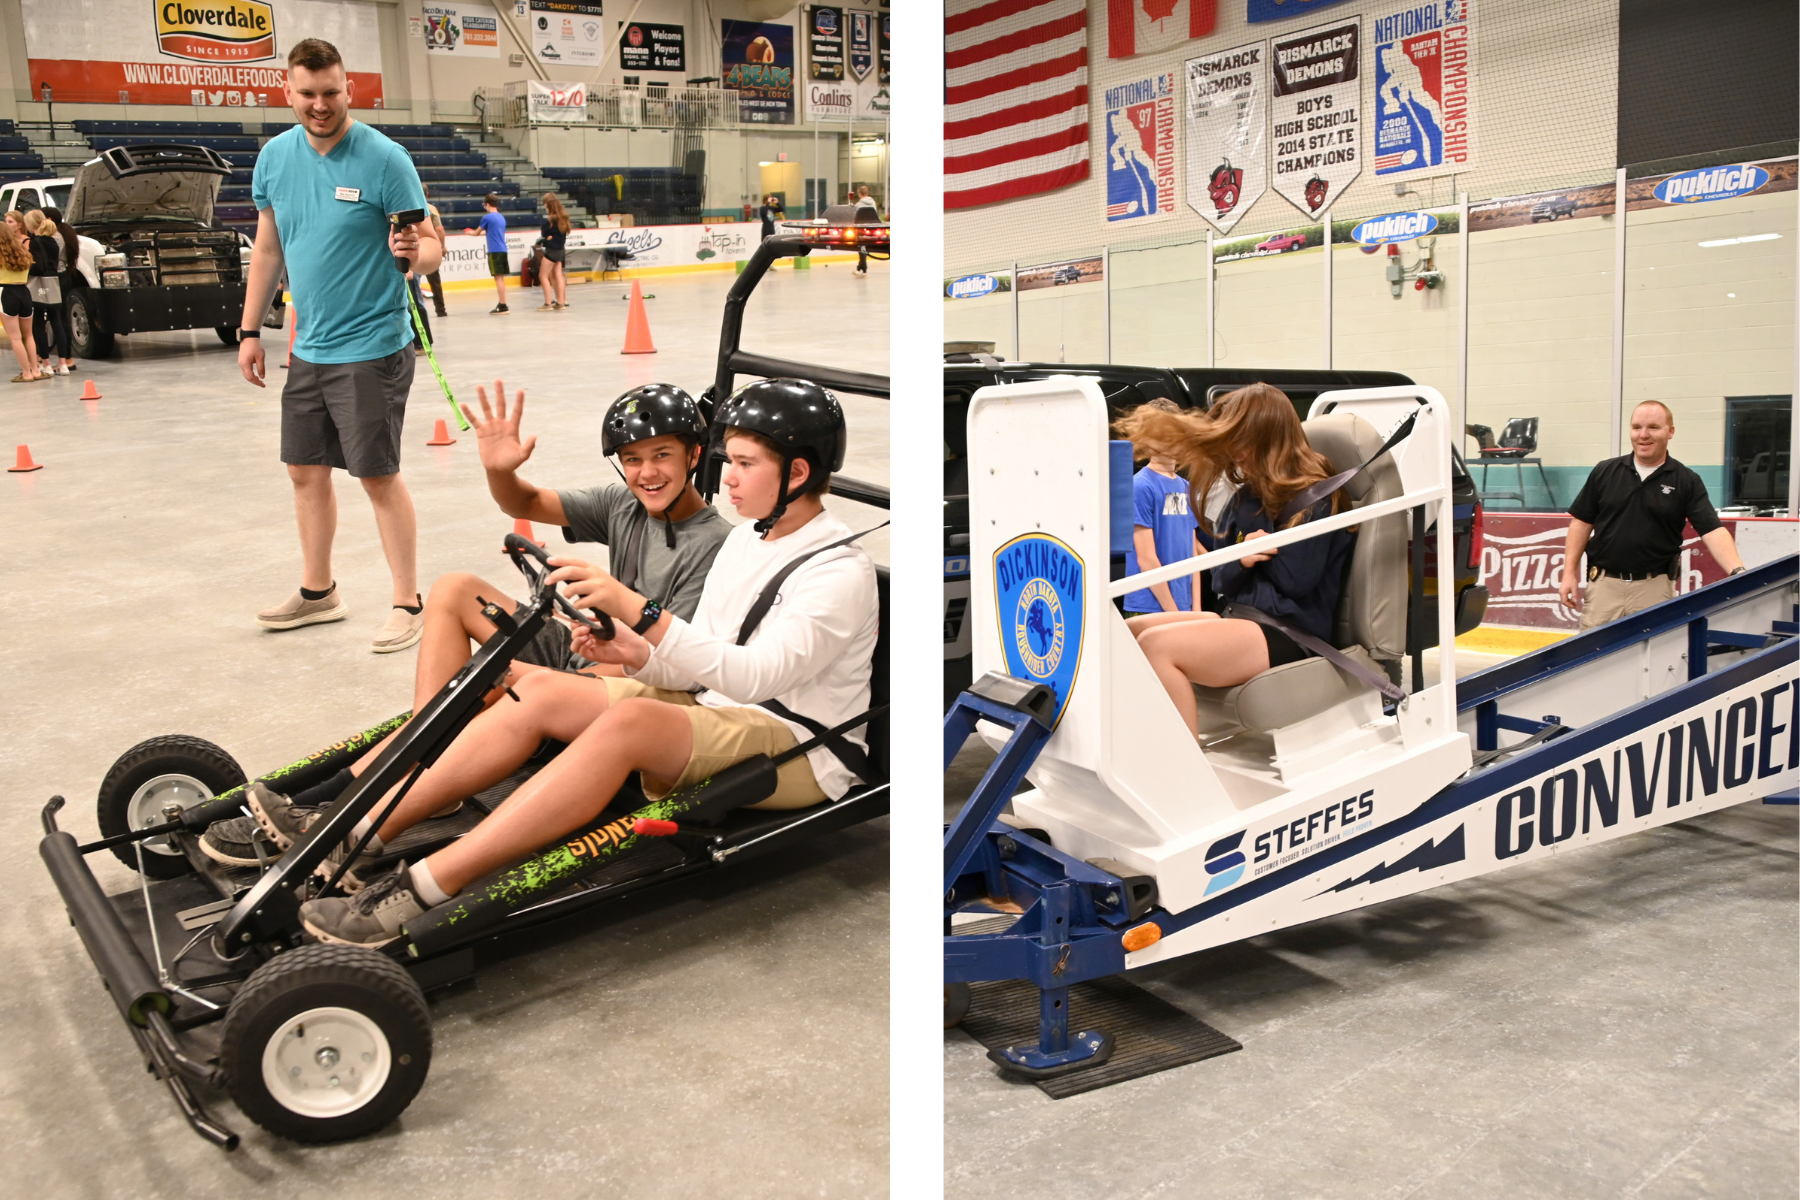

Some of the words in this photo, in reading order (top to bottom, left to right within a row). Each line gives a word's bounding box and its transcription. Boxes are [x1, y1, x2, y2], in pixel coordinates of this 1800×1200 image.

[163, 3, 266, 31] Cloverdale
[517, 5, 524, 14] 13
[463, 22, 496, 30] HEADQUARTERS
[651, 30, 682, 40] Welcome
[1375, 3, 1442, 44] NATIONAL
[186, 45, 219, 55] SINCE
[225, 48, 249, 56] 1915
[654, 43, 680, 55] Players
[1279, 33, 1352, 65] BISMARCK
[1410, 38, 1438, 51] BANTAM
[1413, 50, 1428, 59] TIER
[654, 56, 660, 66] &
[663, 56, 680, 66] Fans!
[1286, 57, 1344, 85] DEMONS
[122, 64, 284, 88] WWW.CLOVERDALEFOODS
[740, 64, 791, 90] BEARS
[1198, 71, 1252, 97] DEMONS
[1106, 78, 1157, 110] NATIONAL
[1297, 95, 1333, 115] BOYS
[1444, 25, 1467, 163] CHAMPIONSHIP
[1274, 119, 1303, 138] HIGH
[1307, 108, 1358, 131] SCHOOL
[1380, 125, 1411, 137] BISMARCK
[1383, 116, 1407, 129] 2000
[1278, 138, 1306, 156] 2014
[1309, 128, 1354, 150] STATE
[1379, 131, 1411, 143] NATIONALS
[1157, 97, 1174, 212] CHAMPIONSHIP
[1277, 147, 1355, 174] CHAMPIONS
[1664, 163, 1757, 203] puklich
[1704, 191, 1737, 200] CHEVROLET
[1502, 195, 1556, 208] chevrolet.com
[1360, 212, 1429, 244] puklich
[952, 274, 993, 298] puklich
[999, 543, 1079, 601] DICKINSON
[1475, 547, 1566, 592] Pizza
[1020, 583, 1037, 610] NORTH
[1038, 582, 1059, 613] DAKOTA
[1017, 624, 1045, 673] ROUGHRIDER
[1046, 622, 1063, 671] COUNTRY
[1254, 789, 1374, 864] STEFFES
[1254, 860, 1278, 876] CUSTOMER
[1301, 843, 1323, 856] SOLUTION
[1324, 834, 1341, 846] DRIVEN.
[1342, 828, 1354, 838] FIELD
